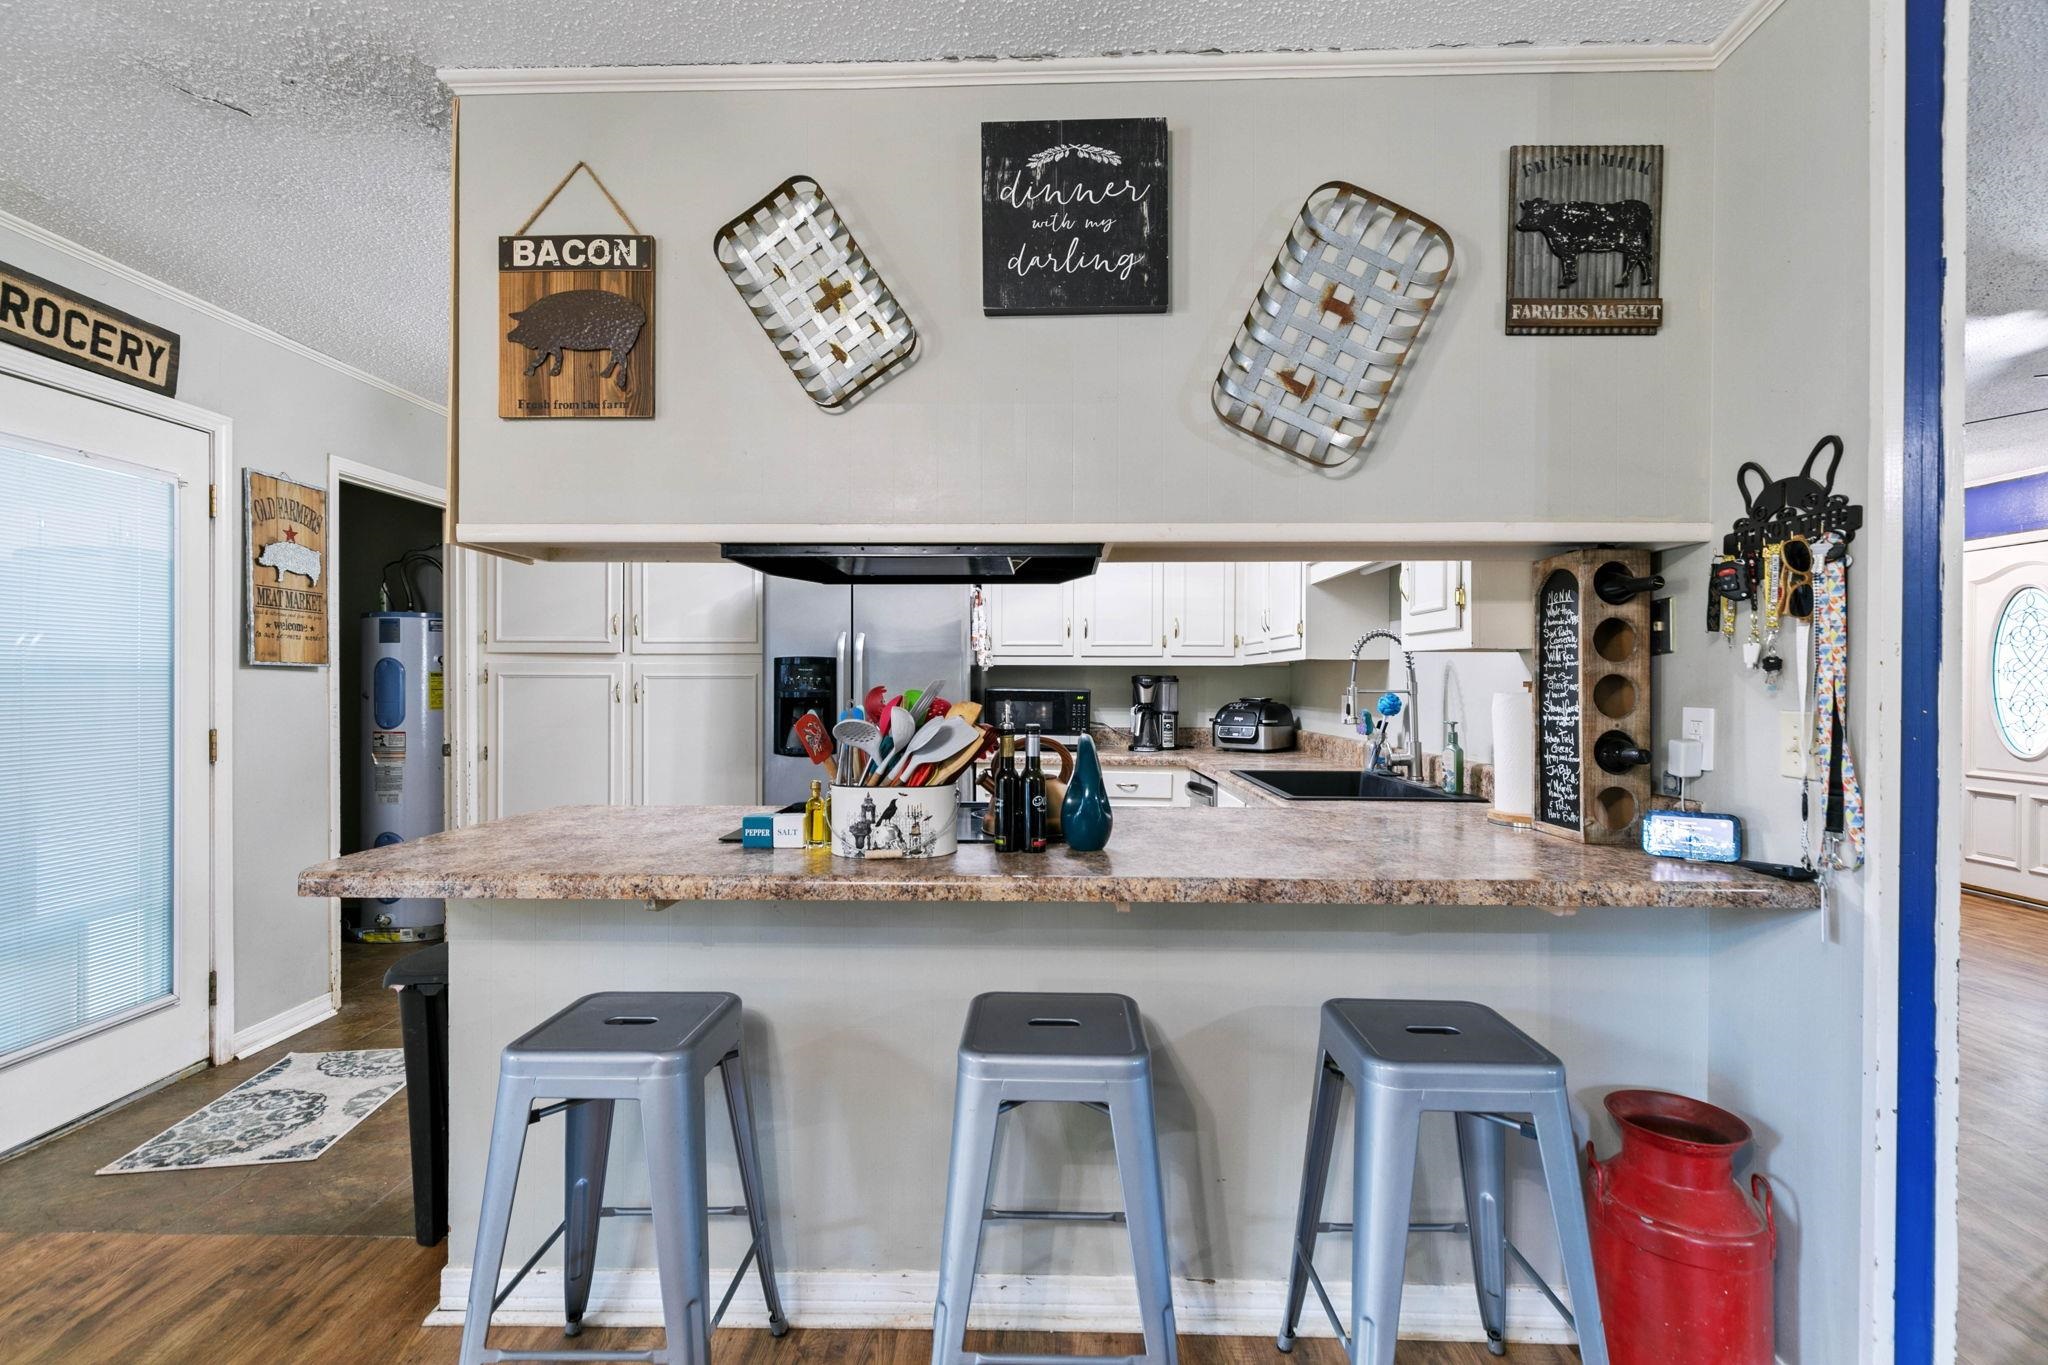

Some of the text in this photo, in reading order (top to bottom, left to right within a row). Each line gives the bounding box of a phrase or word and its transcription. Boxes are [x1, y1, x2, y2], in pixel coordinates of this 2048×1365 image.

[1522, 153, 1590, 178] FRESH
[1000, 169, 1151, 209] dinner
[1031, 212, 1117, 232] with my
[512, 239, 637, 267] BACON
[1007, 237, 1145, 280] darling
[1511, 304, 1662, 320] FARMERS MARKET
[517, 399, 630, 410] Fresh from the farm
[254, 496, 324, 535] OLD FARMERS
[257, 587, 323, 612] MEAT MARKET
[273, 619, 308, 633] welcome
[745, 828, 771, 837] PEPPER
[777, 829, 798, 837] SALT
